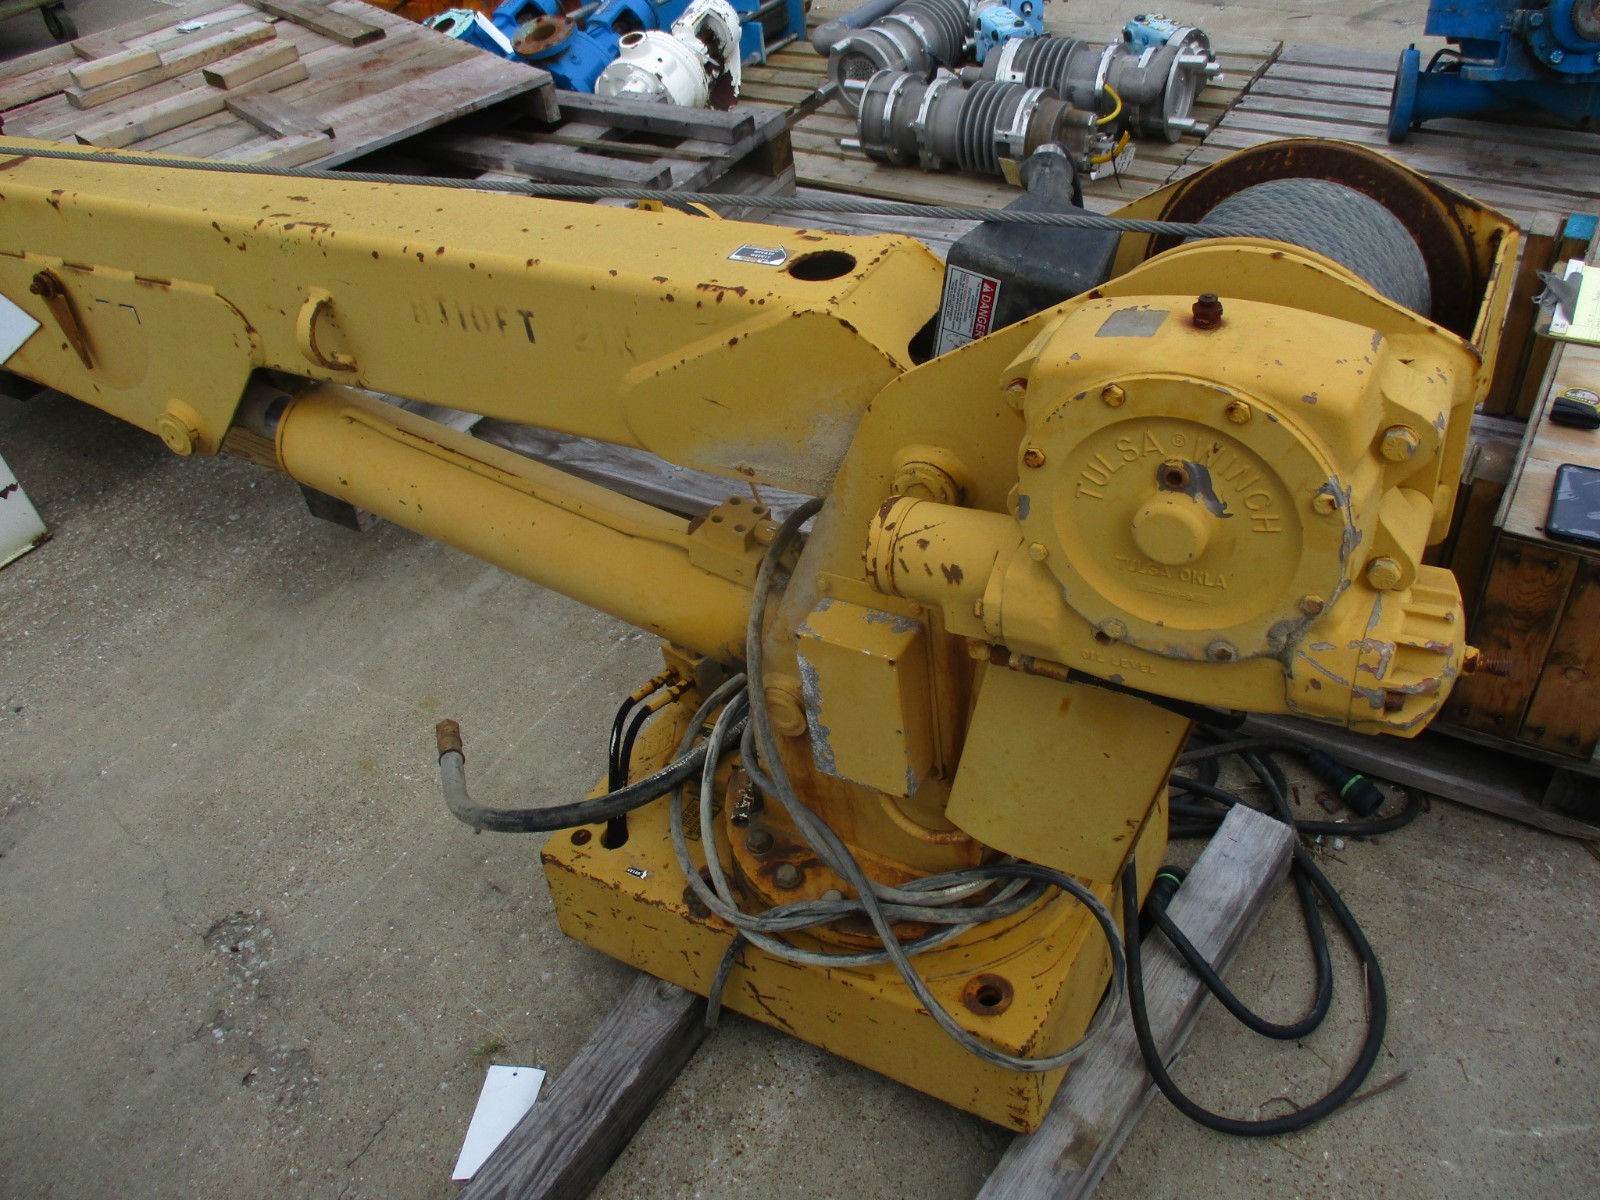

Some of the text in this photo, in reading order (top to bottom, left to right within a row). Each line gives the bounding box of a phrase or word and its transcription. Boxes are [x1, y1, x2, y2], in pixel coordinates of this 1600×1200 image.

[974, 294, 992, 339] DANGER
[1075, 430, 1166, 500] TULSA
[1193, 436, 1282, 532] WINCH
[1115, 554, 1227, 590] TULSA OKLA
[1110, 655, 1157, 676] LEVEL
